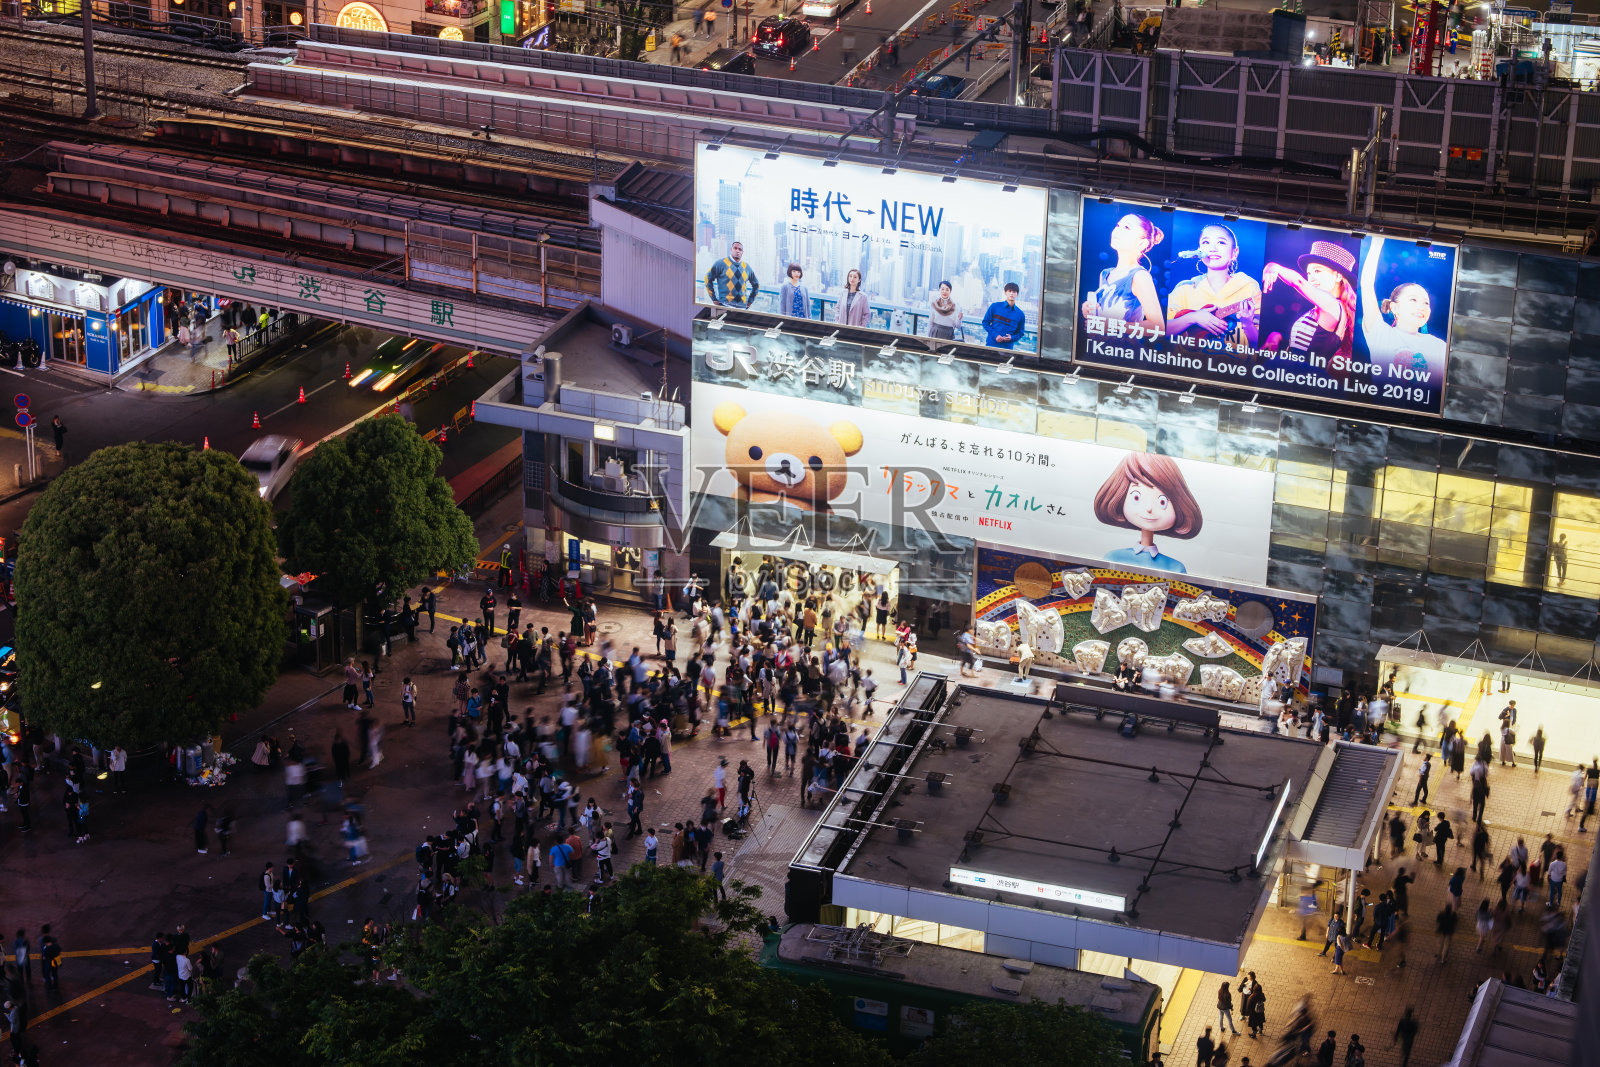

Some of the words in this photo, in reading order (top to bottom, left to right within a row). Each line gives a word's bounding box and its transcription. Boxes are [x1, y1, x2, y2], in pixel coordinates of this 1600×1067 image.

[790, 188, 851, 224] 時代
[881, 199, 944, 237] NEW
[910, 242, 943, 253] SoftBank
[233, 267, 256, 282] JR
[299, 275, 454, 327] 渋谷駅
[705, 343, 758, 376] JR
[767, 351, 856, 390] 渋谷駅
[1086, 315, 1165, 342] 西野カナ
[1170, 334, 1195, 347] LIVE
[1198, 338, 1222, 350] DVD
[1225, 342, 1233, 352] &
[1237, 344, 1277, 359] Blu-ray
[1280, 349, 1306, 363] Disc
[1310, 352, 1326, 368] In
[1332, 355, 1382, 376] Store
[1388, 363, 1431, 383] Now
[1139, 347, 1202, 369] Nishino
[1207, 357, 1247, 376] Love
[1252, 364, 1338, 390] Collection
[1343, 377, 1378, 395] Live
[864, 377, 939, 402] shibuya
[945, 389, 1010, 413] station
[900, 433, 1056, 468] がんばる、を忘れる10分間。
[968, 490, 975, 499] と
[985, 484, 1042, 511] カオル
[1046, 503, 1066, 516] さん
[979, 516, 1012, 531] NETFLIX
